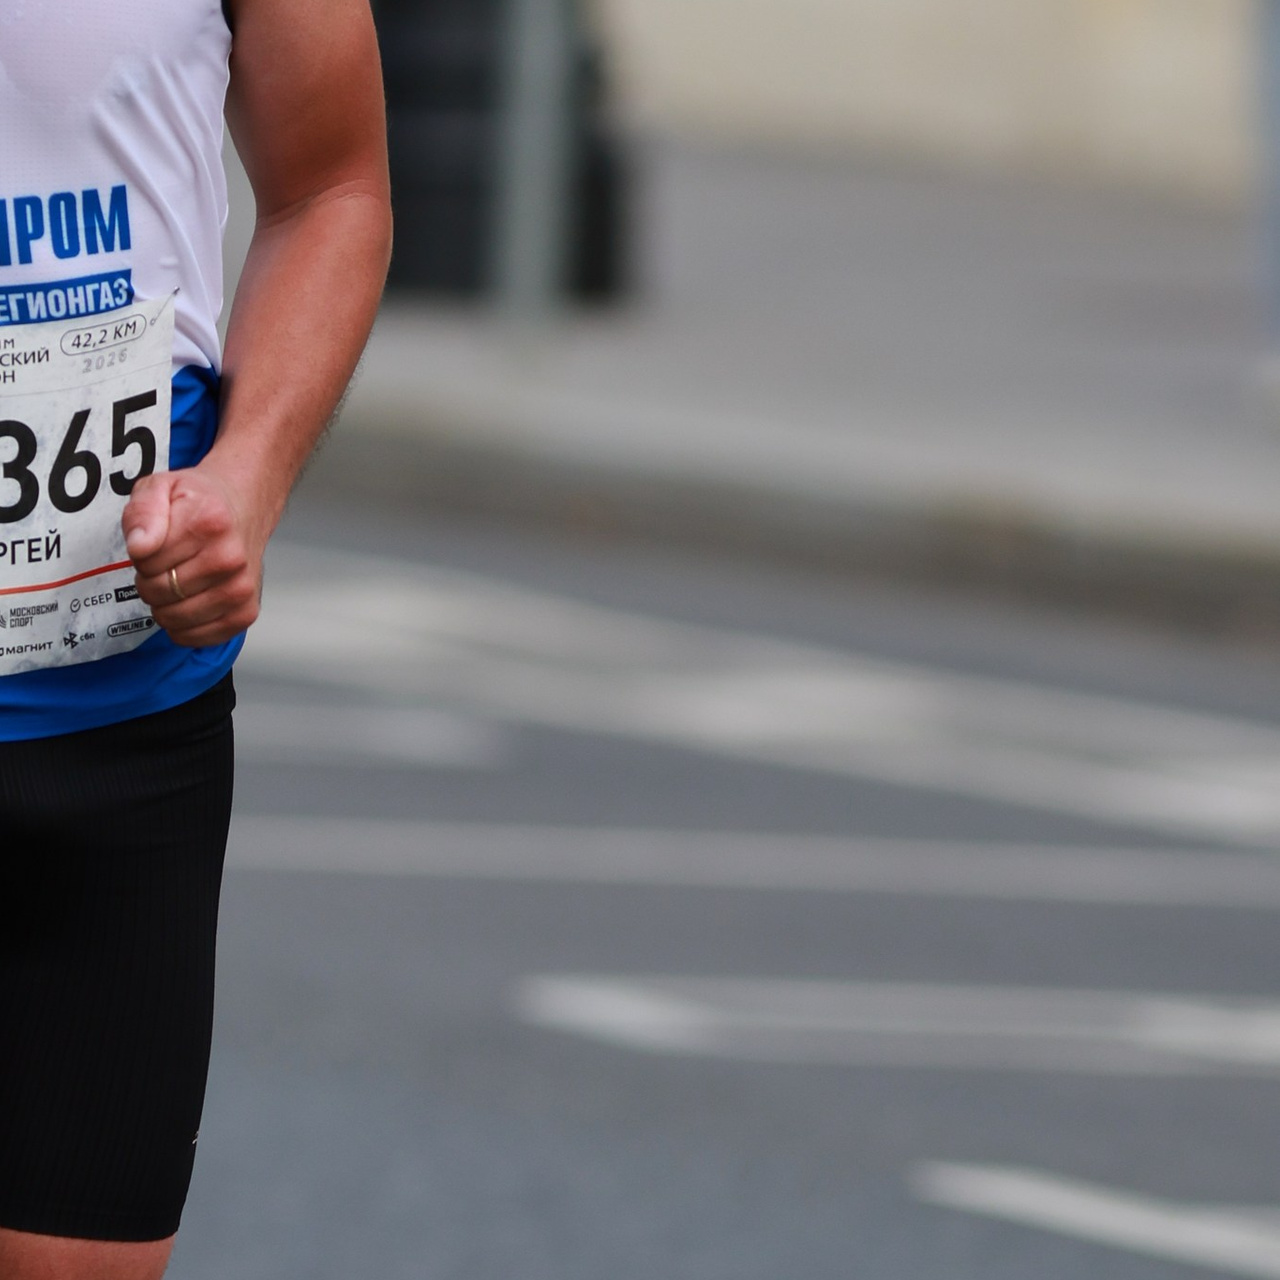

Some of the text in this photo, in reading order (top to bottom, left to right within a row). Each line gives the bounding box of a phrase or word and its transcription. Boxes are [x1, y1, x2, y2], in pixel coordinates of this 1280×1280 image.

[70, 328, 108, 349] 42,2
[83, 587, 138, 608] СБЕР Прай
[9, 600, 59, 617] МОСКОВСКИЙ
[9, 616, 34, 628] СПОРТ
[110, 620, 144, 635] WINLINE
